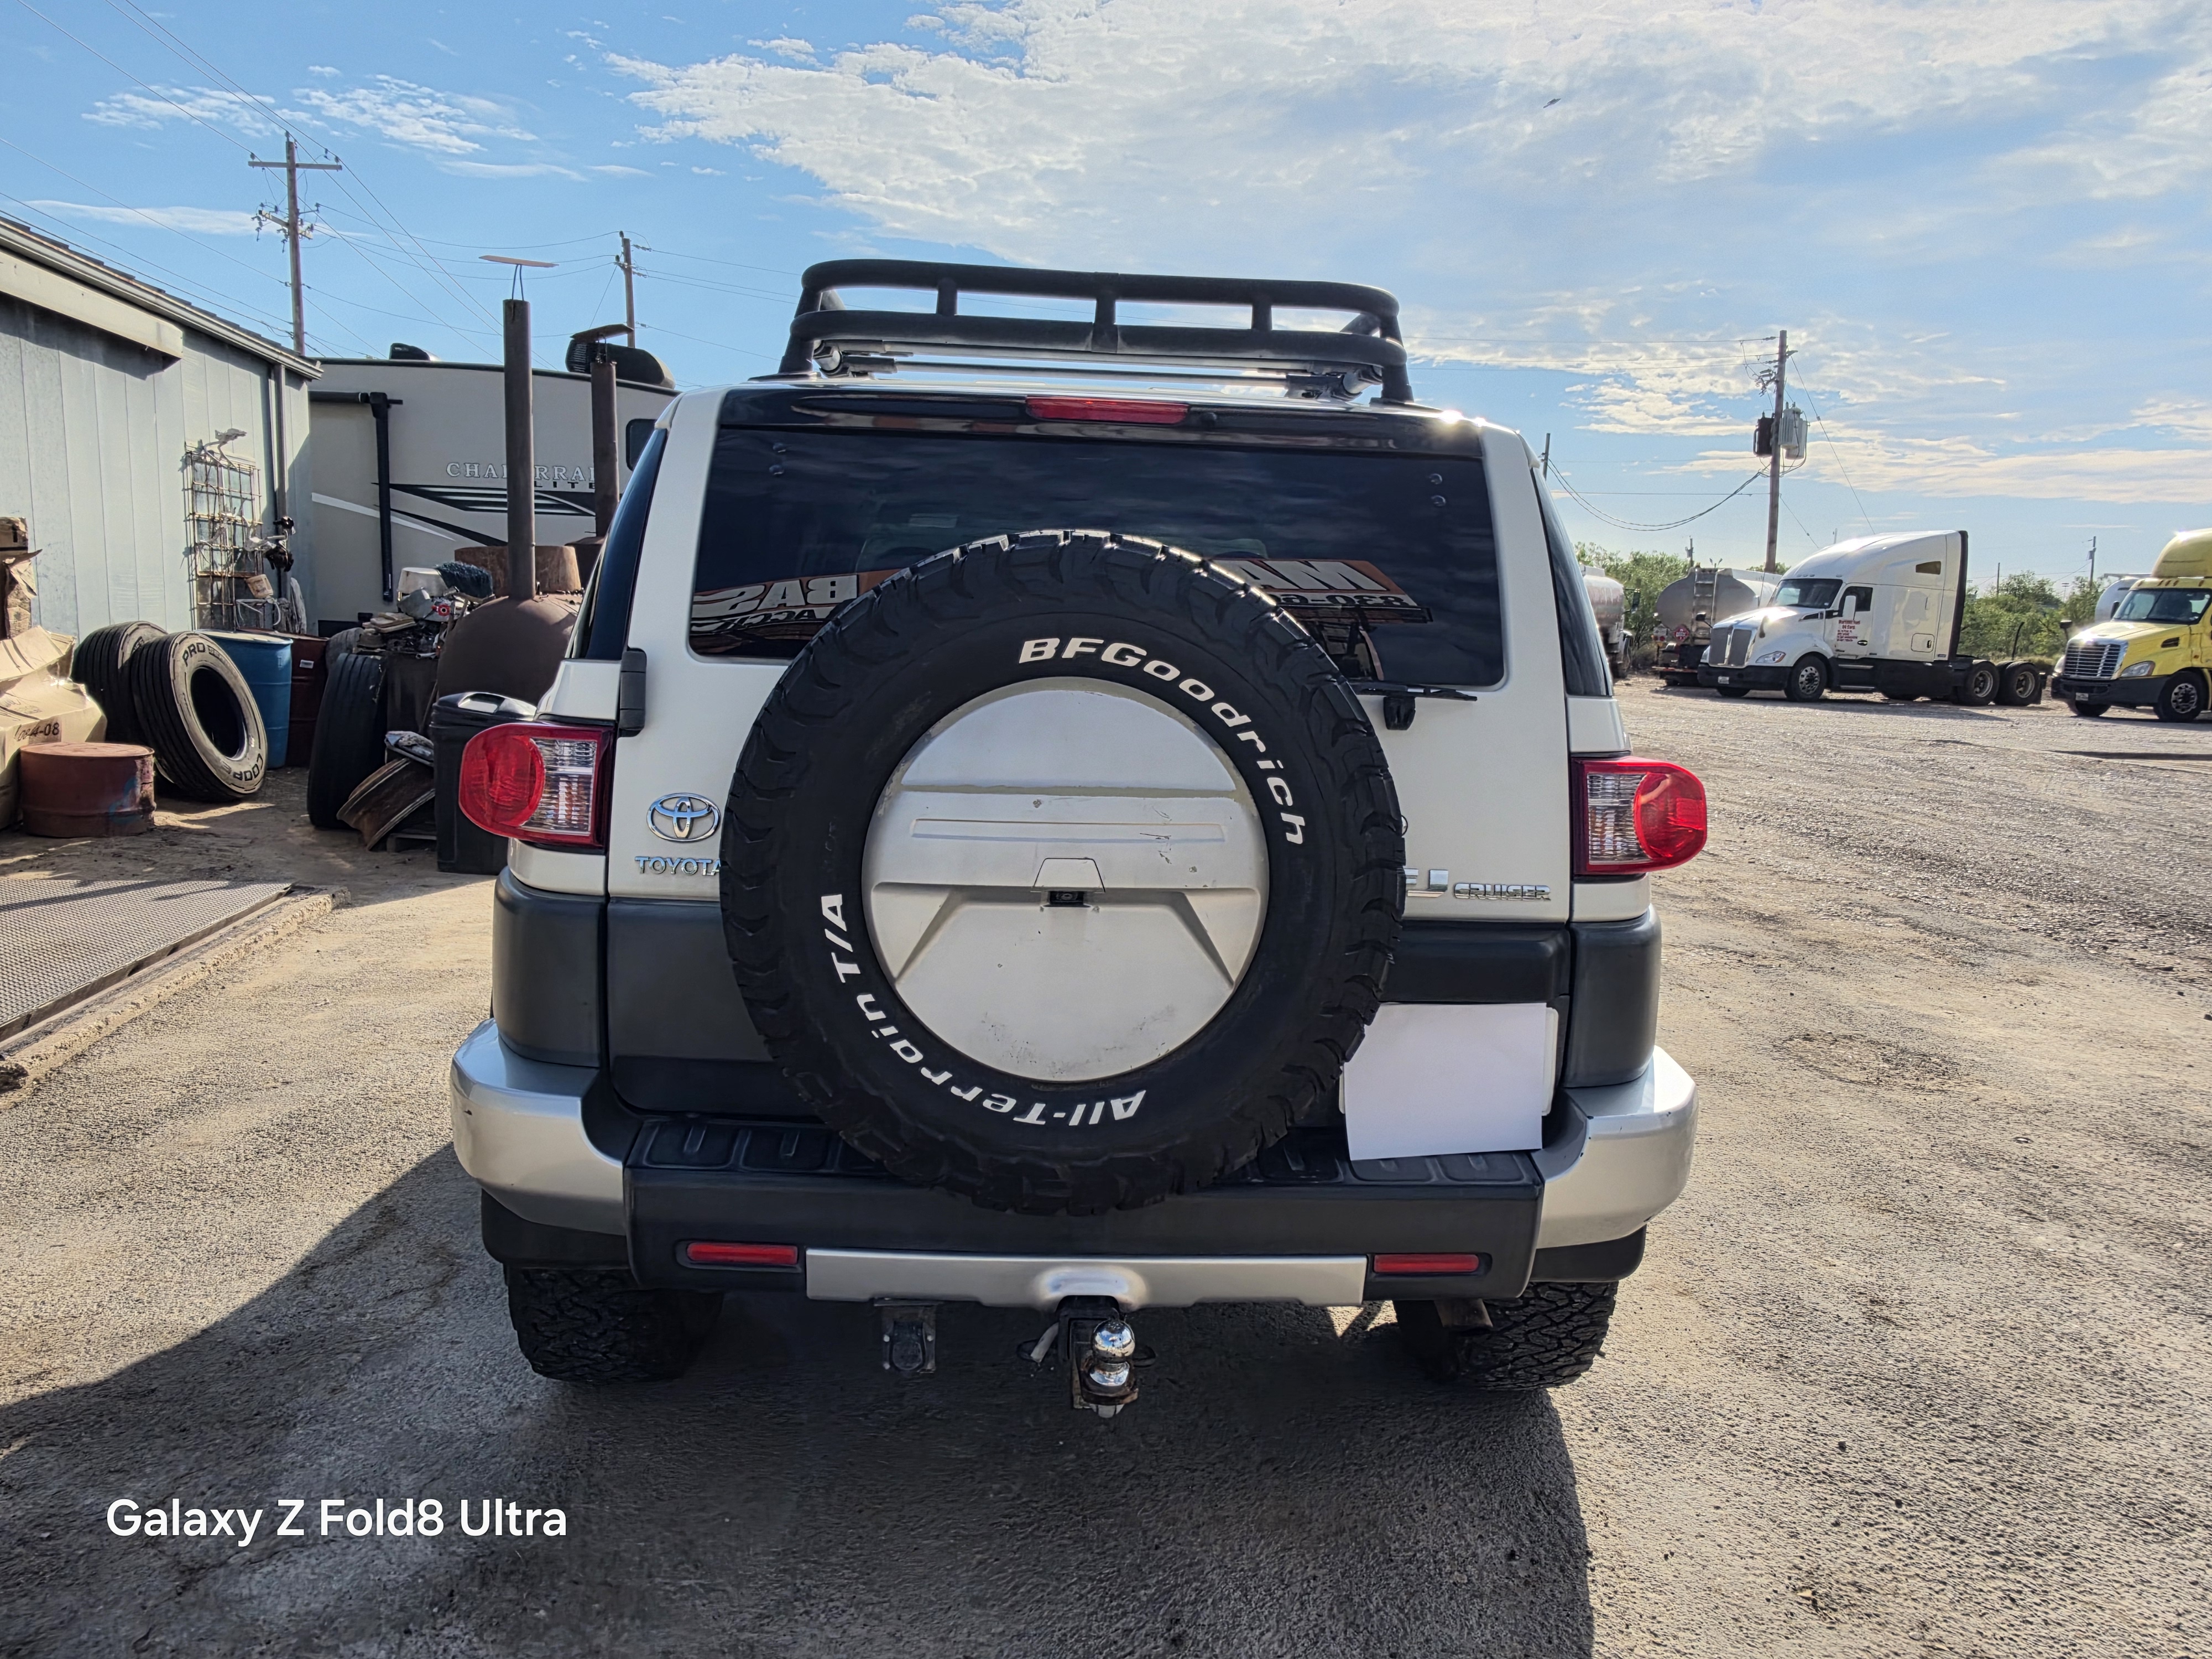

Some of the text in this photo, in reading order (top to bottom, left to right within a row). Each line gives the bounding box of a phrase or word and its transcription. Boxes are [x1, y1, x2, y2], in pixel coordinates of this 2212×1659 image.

[446, 462, 595, 482] CHARRA
[182, 642, 206, 667] PRO
[1018, 637, 1306, 845] BFGoodrich
[222, 753, 264, 782] COOPE
[634, 856, 721, 876] TOYOTA
[1454, 883, 1551, 901] CRUISER
[820, 893, 1147, 1126] All-Terrain T/A
